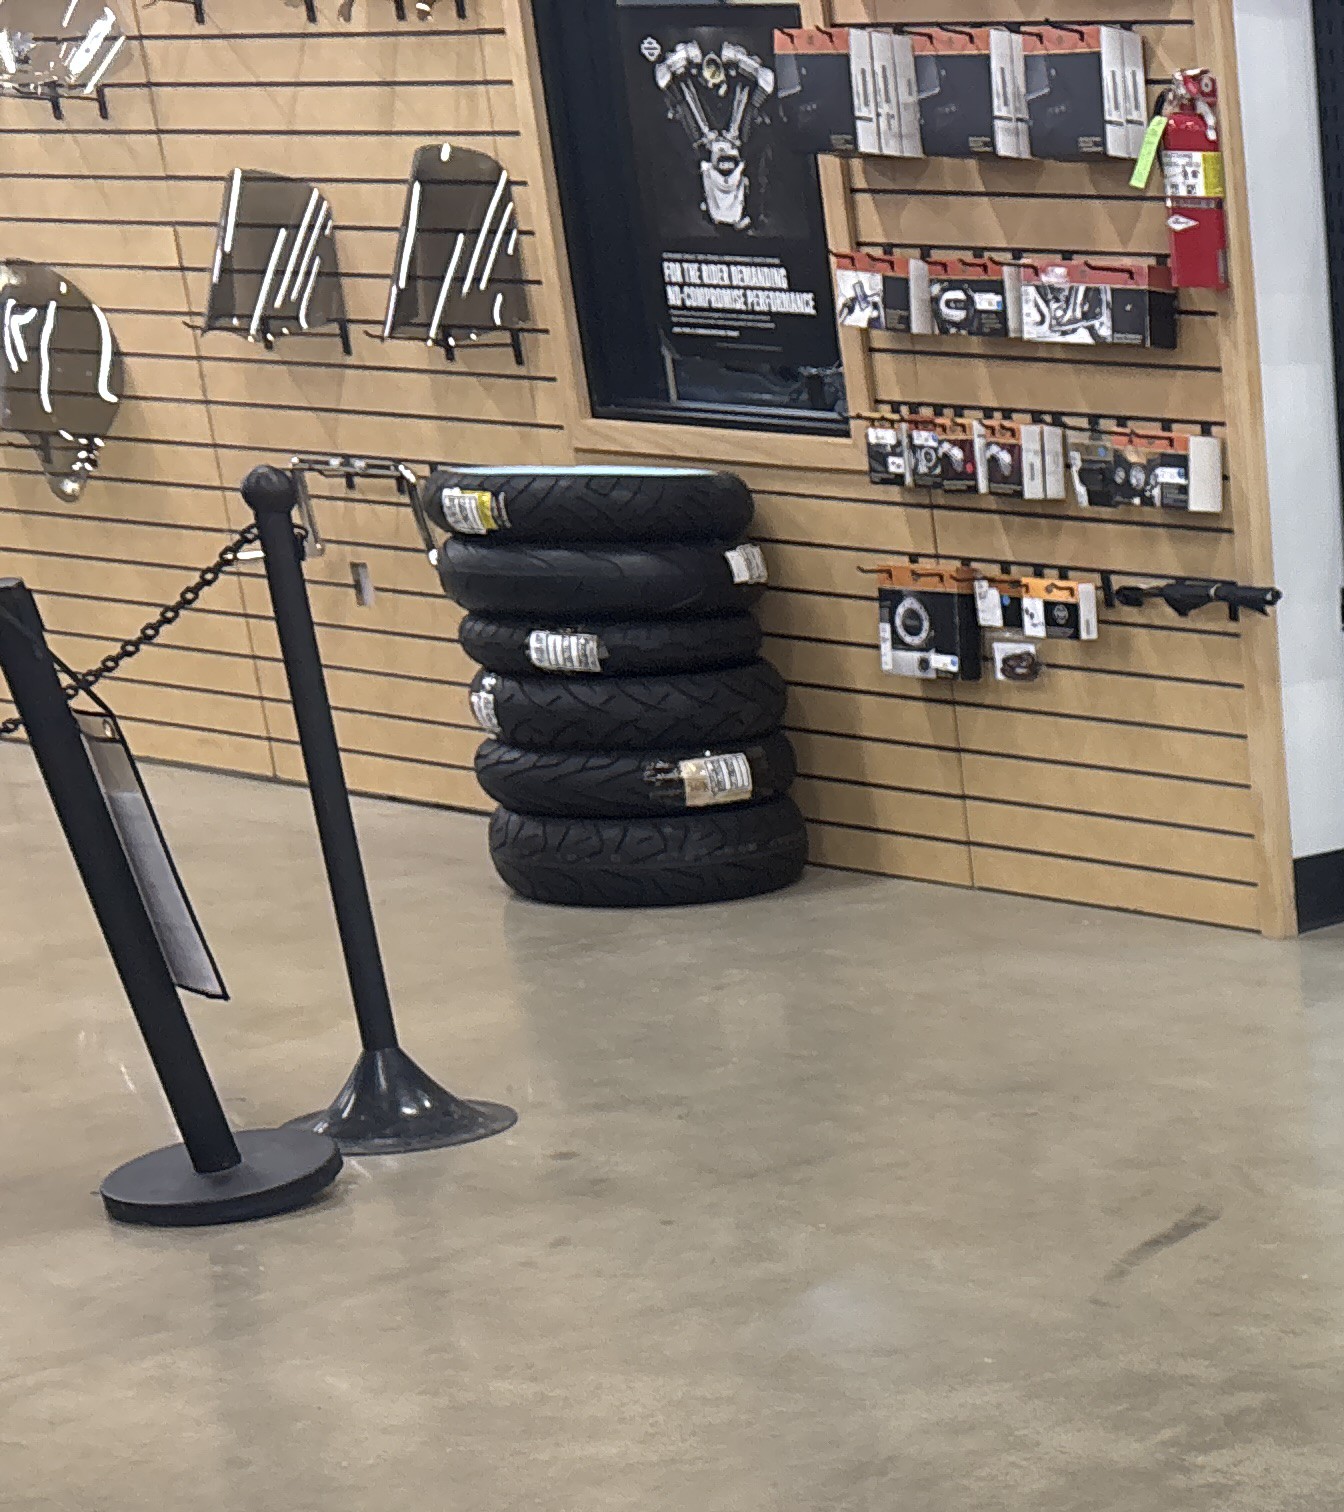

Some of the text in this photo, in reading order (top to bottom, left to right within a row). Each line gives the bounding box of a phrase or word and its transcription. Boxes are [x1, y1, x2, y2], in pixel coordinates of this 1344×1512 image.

[662, 261, 788, 289] FOR THE RIDER DEMANDING
[666, 285, 746, 310] NO-COMPROMISE
[746, 290, 817, 316] PERFORMANCE
